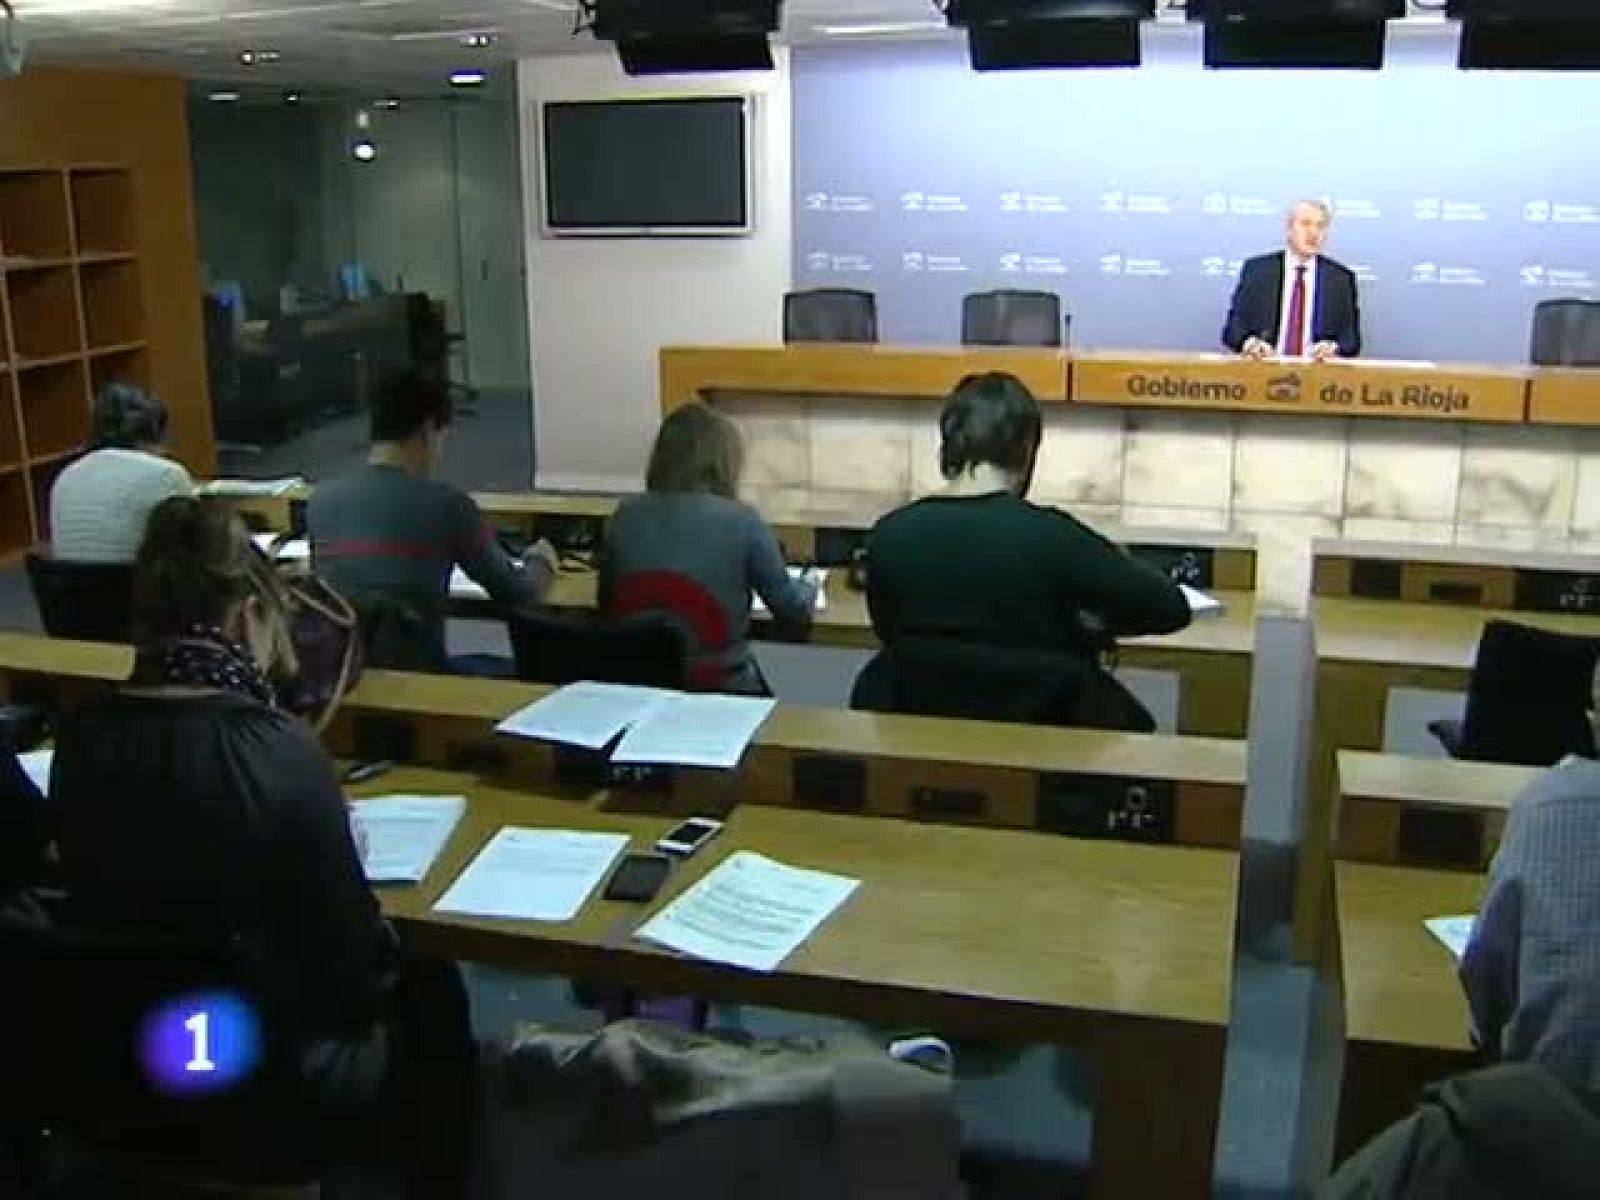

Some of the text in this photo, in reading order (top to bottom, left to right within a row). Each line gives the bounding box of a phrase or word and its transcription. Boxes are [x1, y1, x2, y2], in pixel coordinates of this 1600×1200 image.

[1126, 374, 1471, 412] Gobierno de La Rioja
